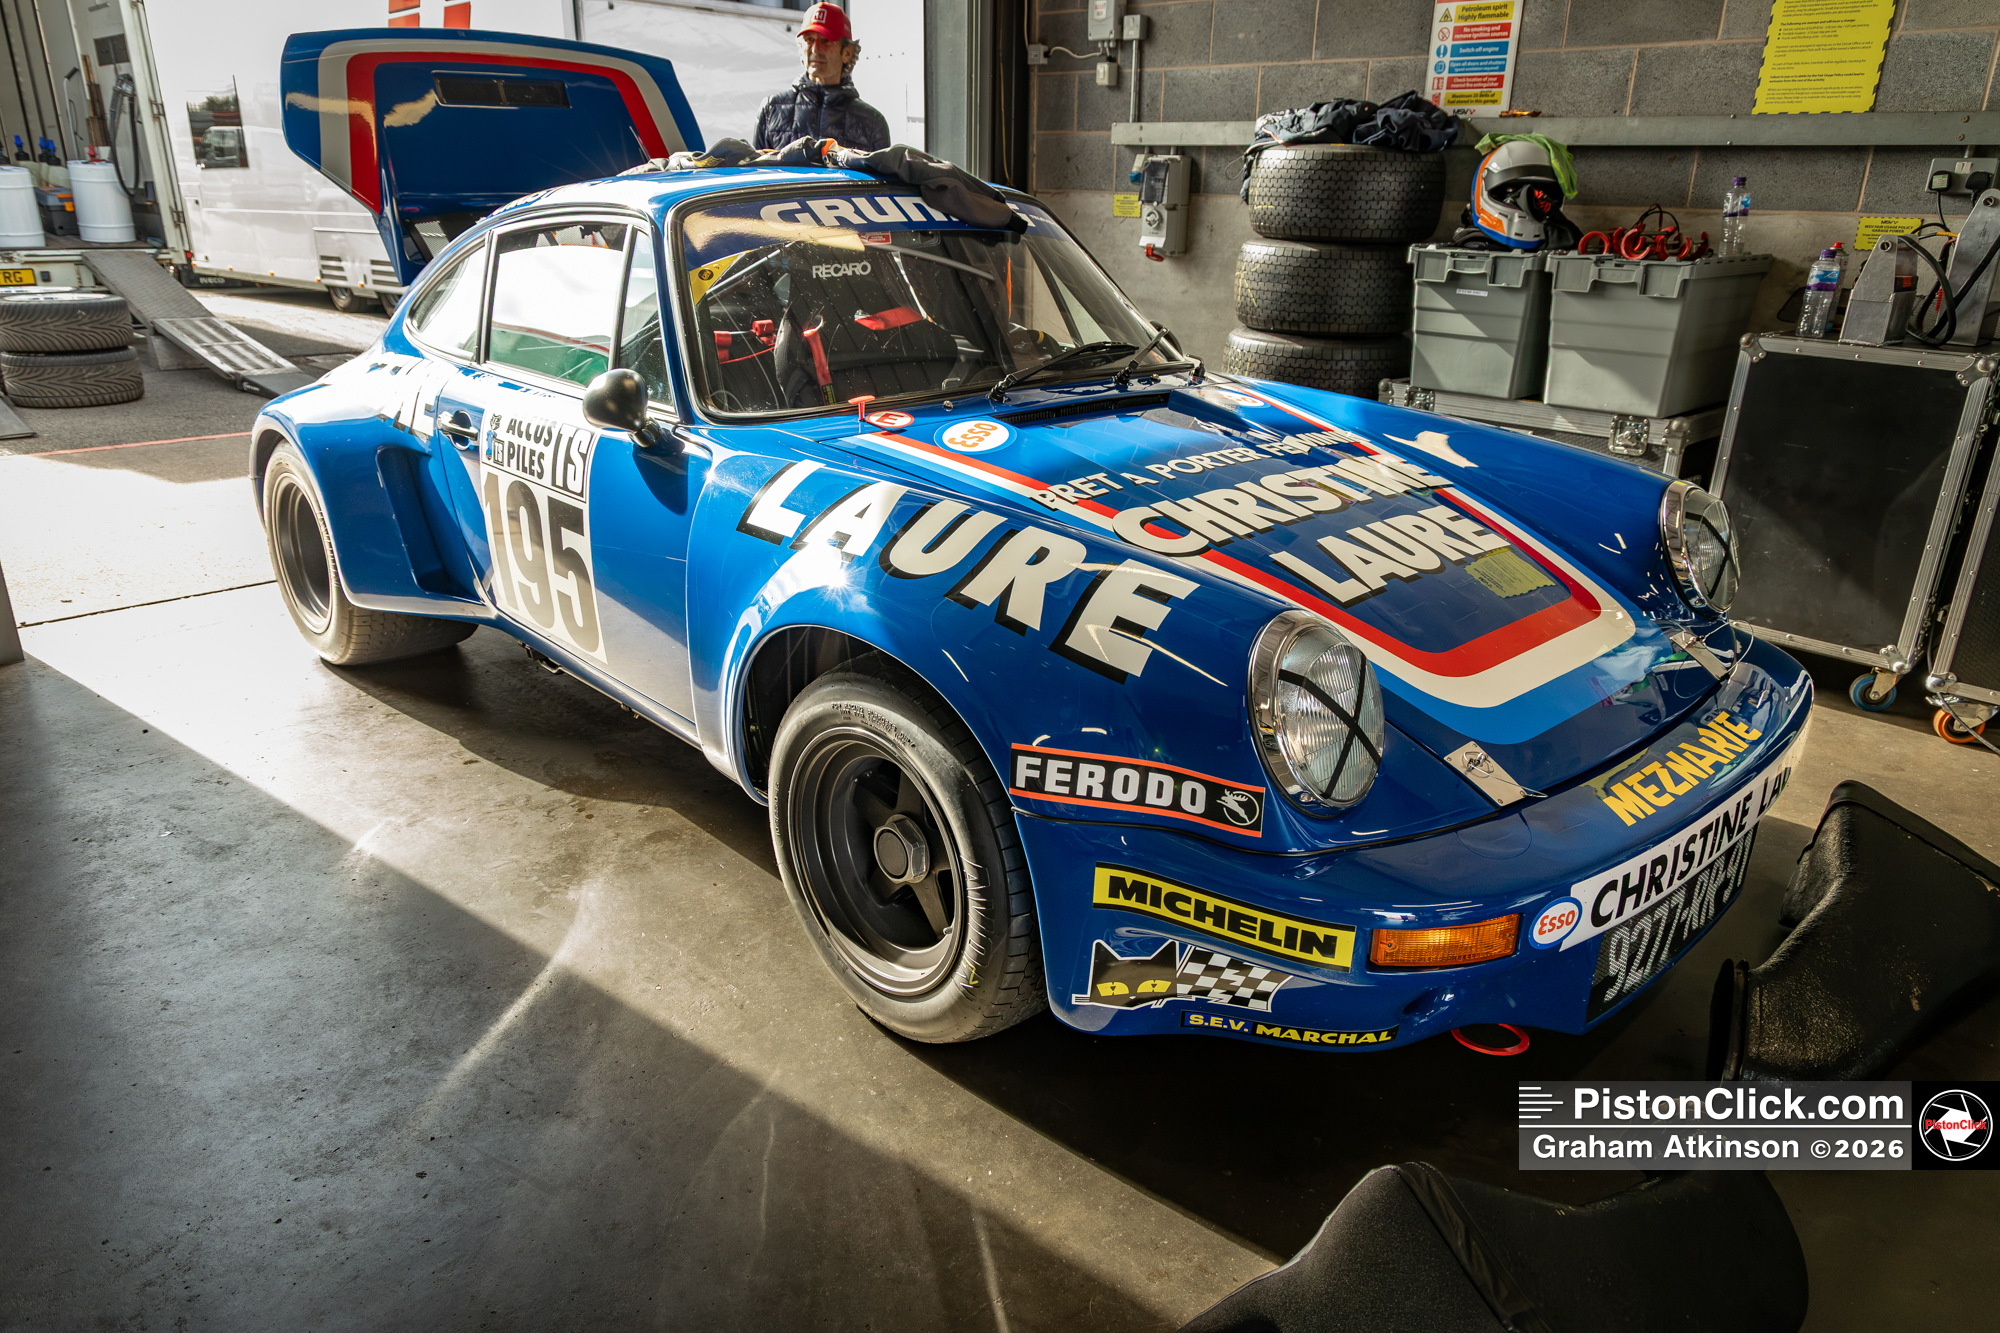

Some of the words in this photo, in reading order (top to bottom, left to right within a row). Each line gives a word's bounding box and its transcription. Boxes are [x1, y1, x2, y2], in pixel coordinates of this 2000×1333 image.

[698, 219, 758, 239] TELEVISION
[0, 271, 23, 283] RG
[812, 261, 872, 279] RECARO
[876, 412, 904, 425] E
[507, 440, 545, 480] PILES
[555, 422, 591, 498] TS
[1029, 472, 1122, 510] PRET
[1118, 471, 1158, 489] A
[1145, 446, 1273, 480] PORTER
[1113, 454, 1455, 557] CHRISTINE
[484, 471, 600, 653] 195
[735, 458, 1201, 685] LAURE
[1269, 505, 1512, 605] LAURE
[1015, 756, 1207, 814] FERODO
[1590, 791, 1753, 928] CHRISTINE
[1108, 876, 1338, 959] MICHELIN
[1188, 1014, 1249, 1032] S.E.V.
[1256, 1024, 1392, 1044] MARCHAL
